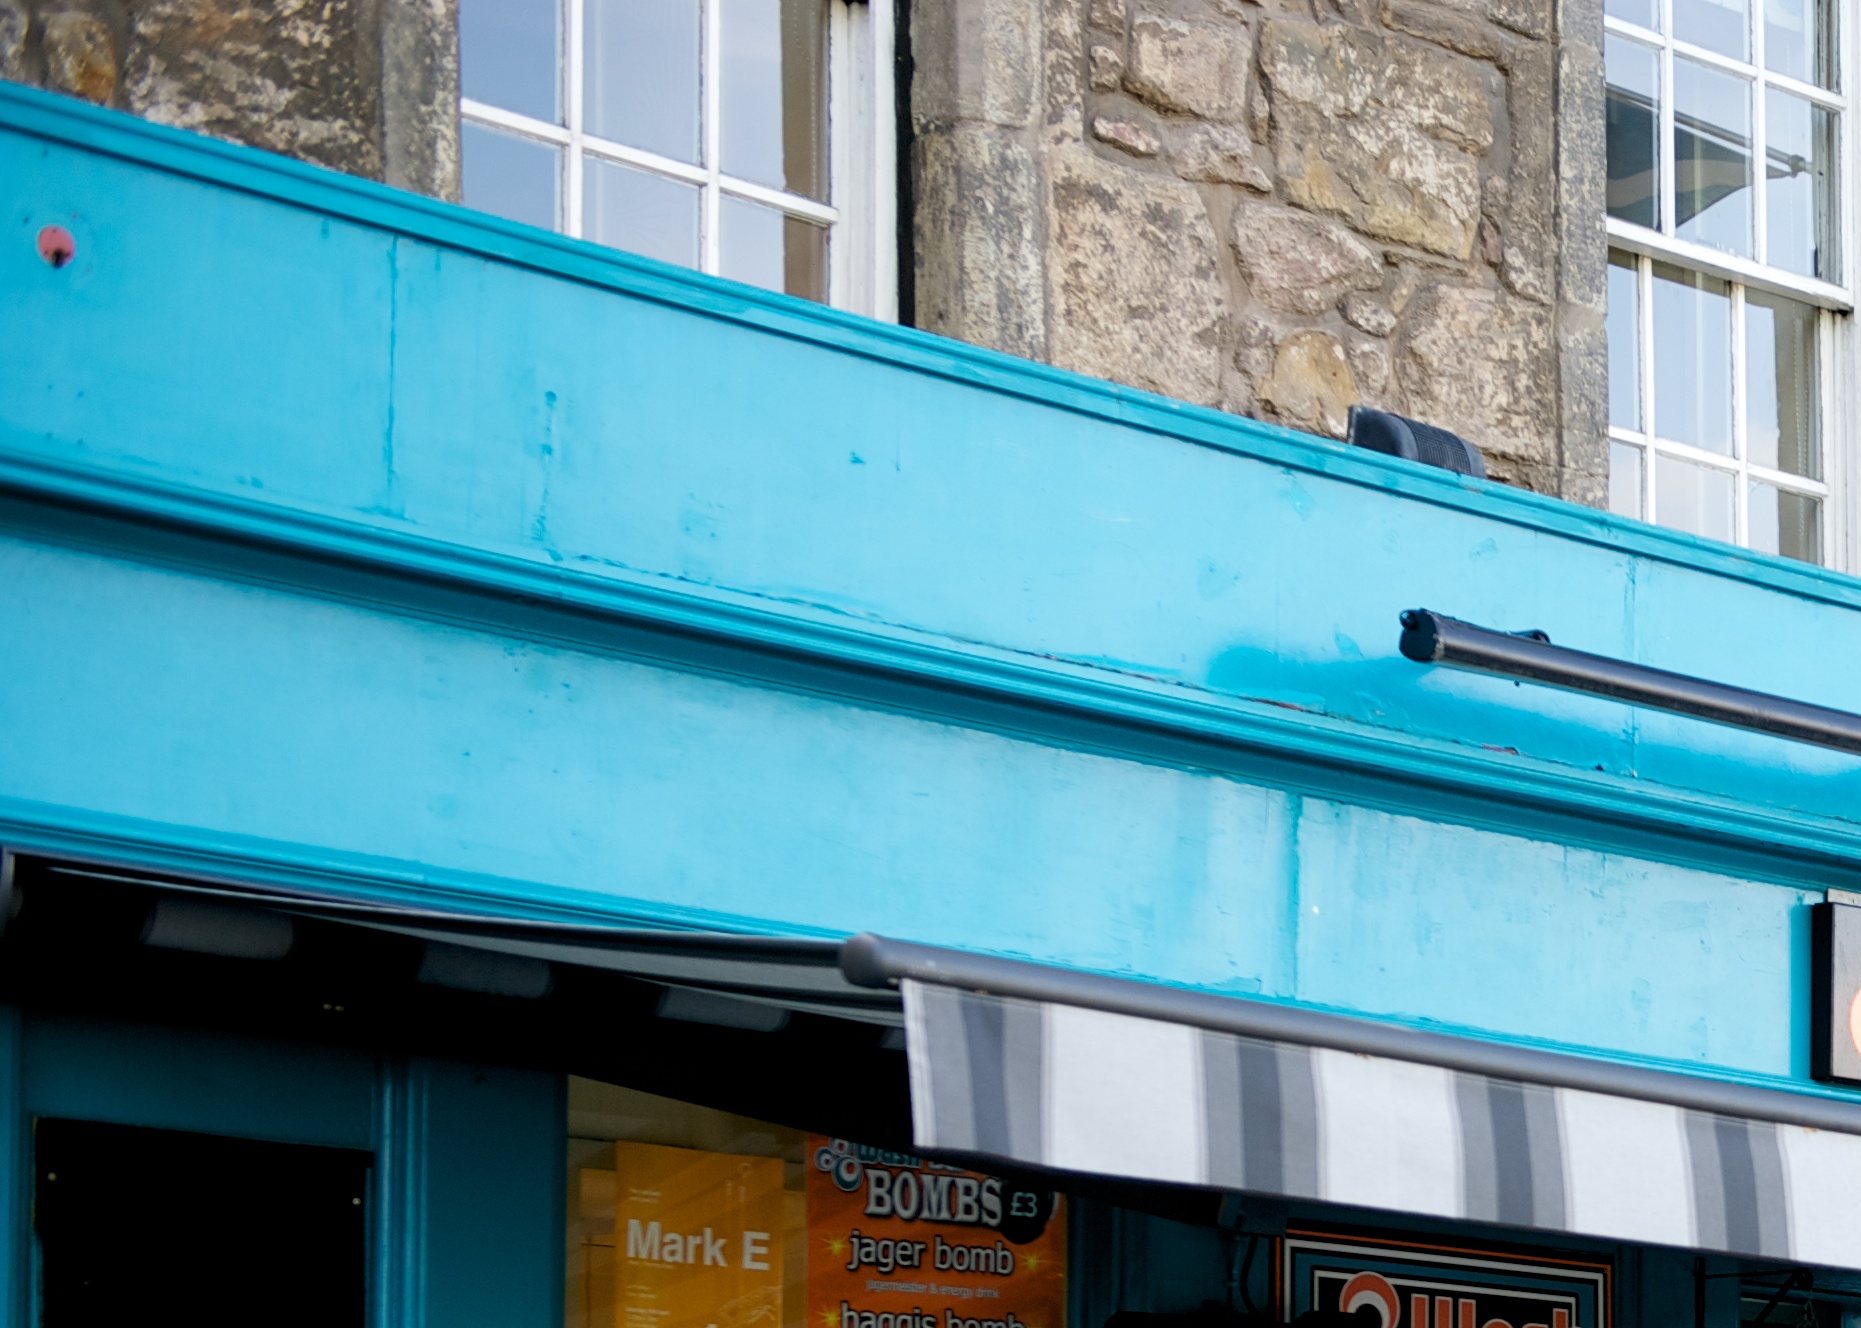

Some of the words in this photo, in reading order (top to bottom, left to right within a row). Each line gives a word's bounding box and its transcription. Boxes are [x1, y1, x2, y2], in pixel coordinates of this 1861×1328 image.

[864, 1167, 1002, 1228] BOMBS
[1010, 1191, 1038, 1218] £3
[626, 1218, 728, 1268] Mark
[741, 1230, 770, 1270] E
[846, 1228, 926, 1273] jager
[933, 1235, 1014, 1276] bomb
